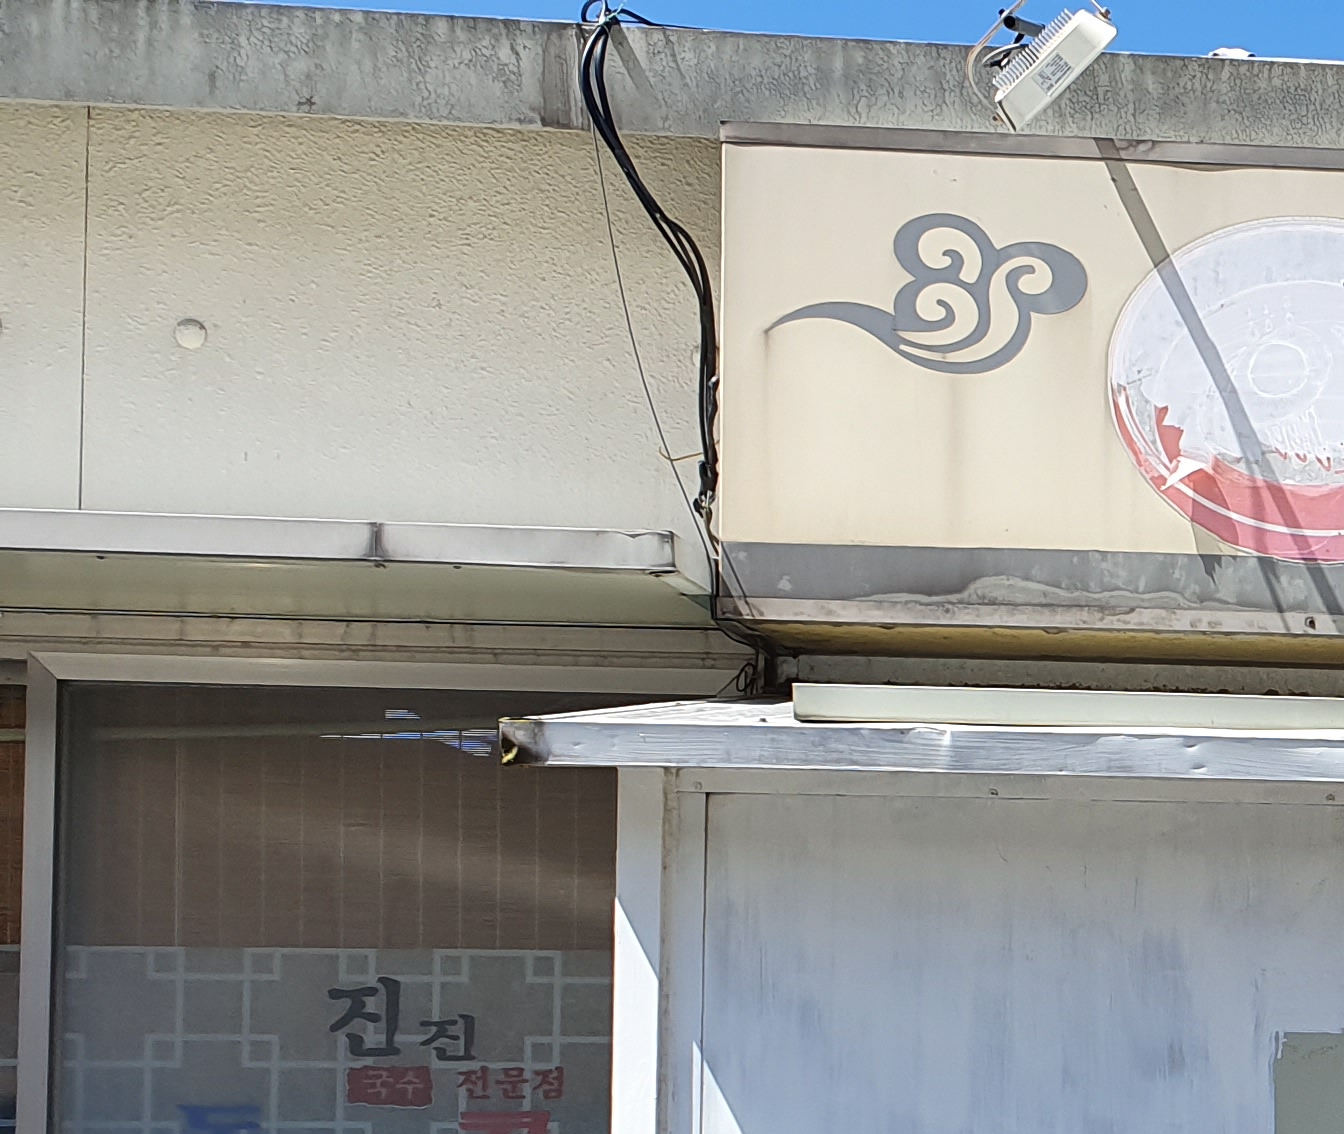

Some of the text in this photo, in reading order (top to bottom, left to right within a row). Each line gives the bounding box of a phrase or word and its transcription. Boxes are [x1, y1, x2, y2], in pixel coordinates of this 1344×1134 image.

[327, 976, 477, 1062] 진 진
[361, 1065, 565, 1100] 국수 전문점
